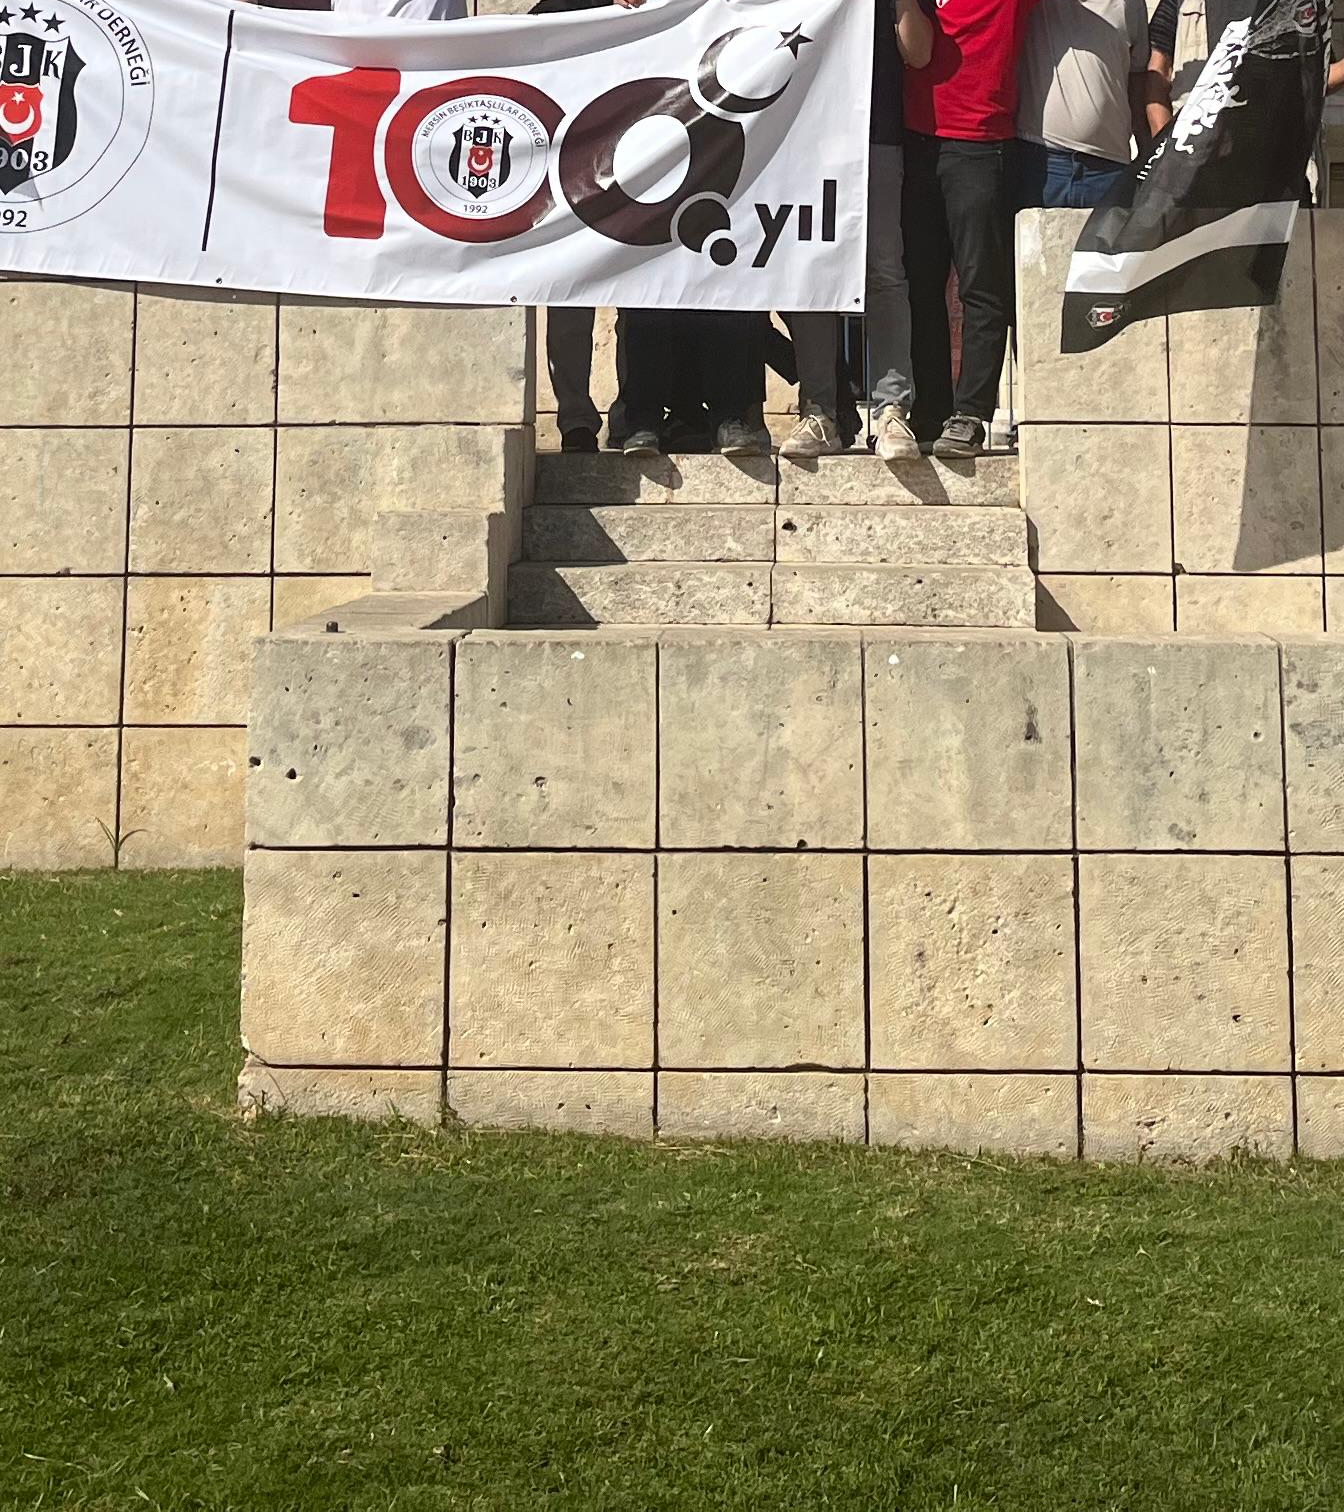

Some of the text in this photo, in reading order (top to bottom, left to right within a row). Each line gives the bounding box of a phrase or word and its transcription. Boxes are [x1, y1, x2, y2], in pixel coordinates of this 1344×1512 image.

[96, 6, 151, 88] DERNEĞİ
[420, 99, 546, 149] MERSİN BEŞİKTAŞLILAR DERNEĞİ
[463, 129, 503, 145] BJK
[461, 175, 497, 188] 1903
[463, 204, 489, 215] 1992
[750, 178, 838, 269] yıl
